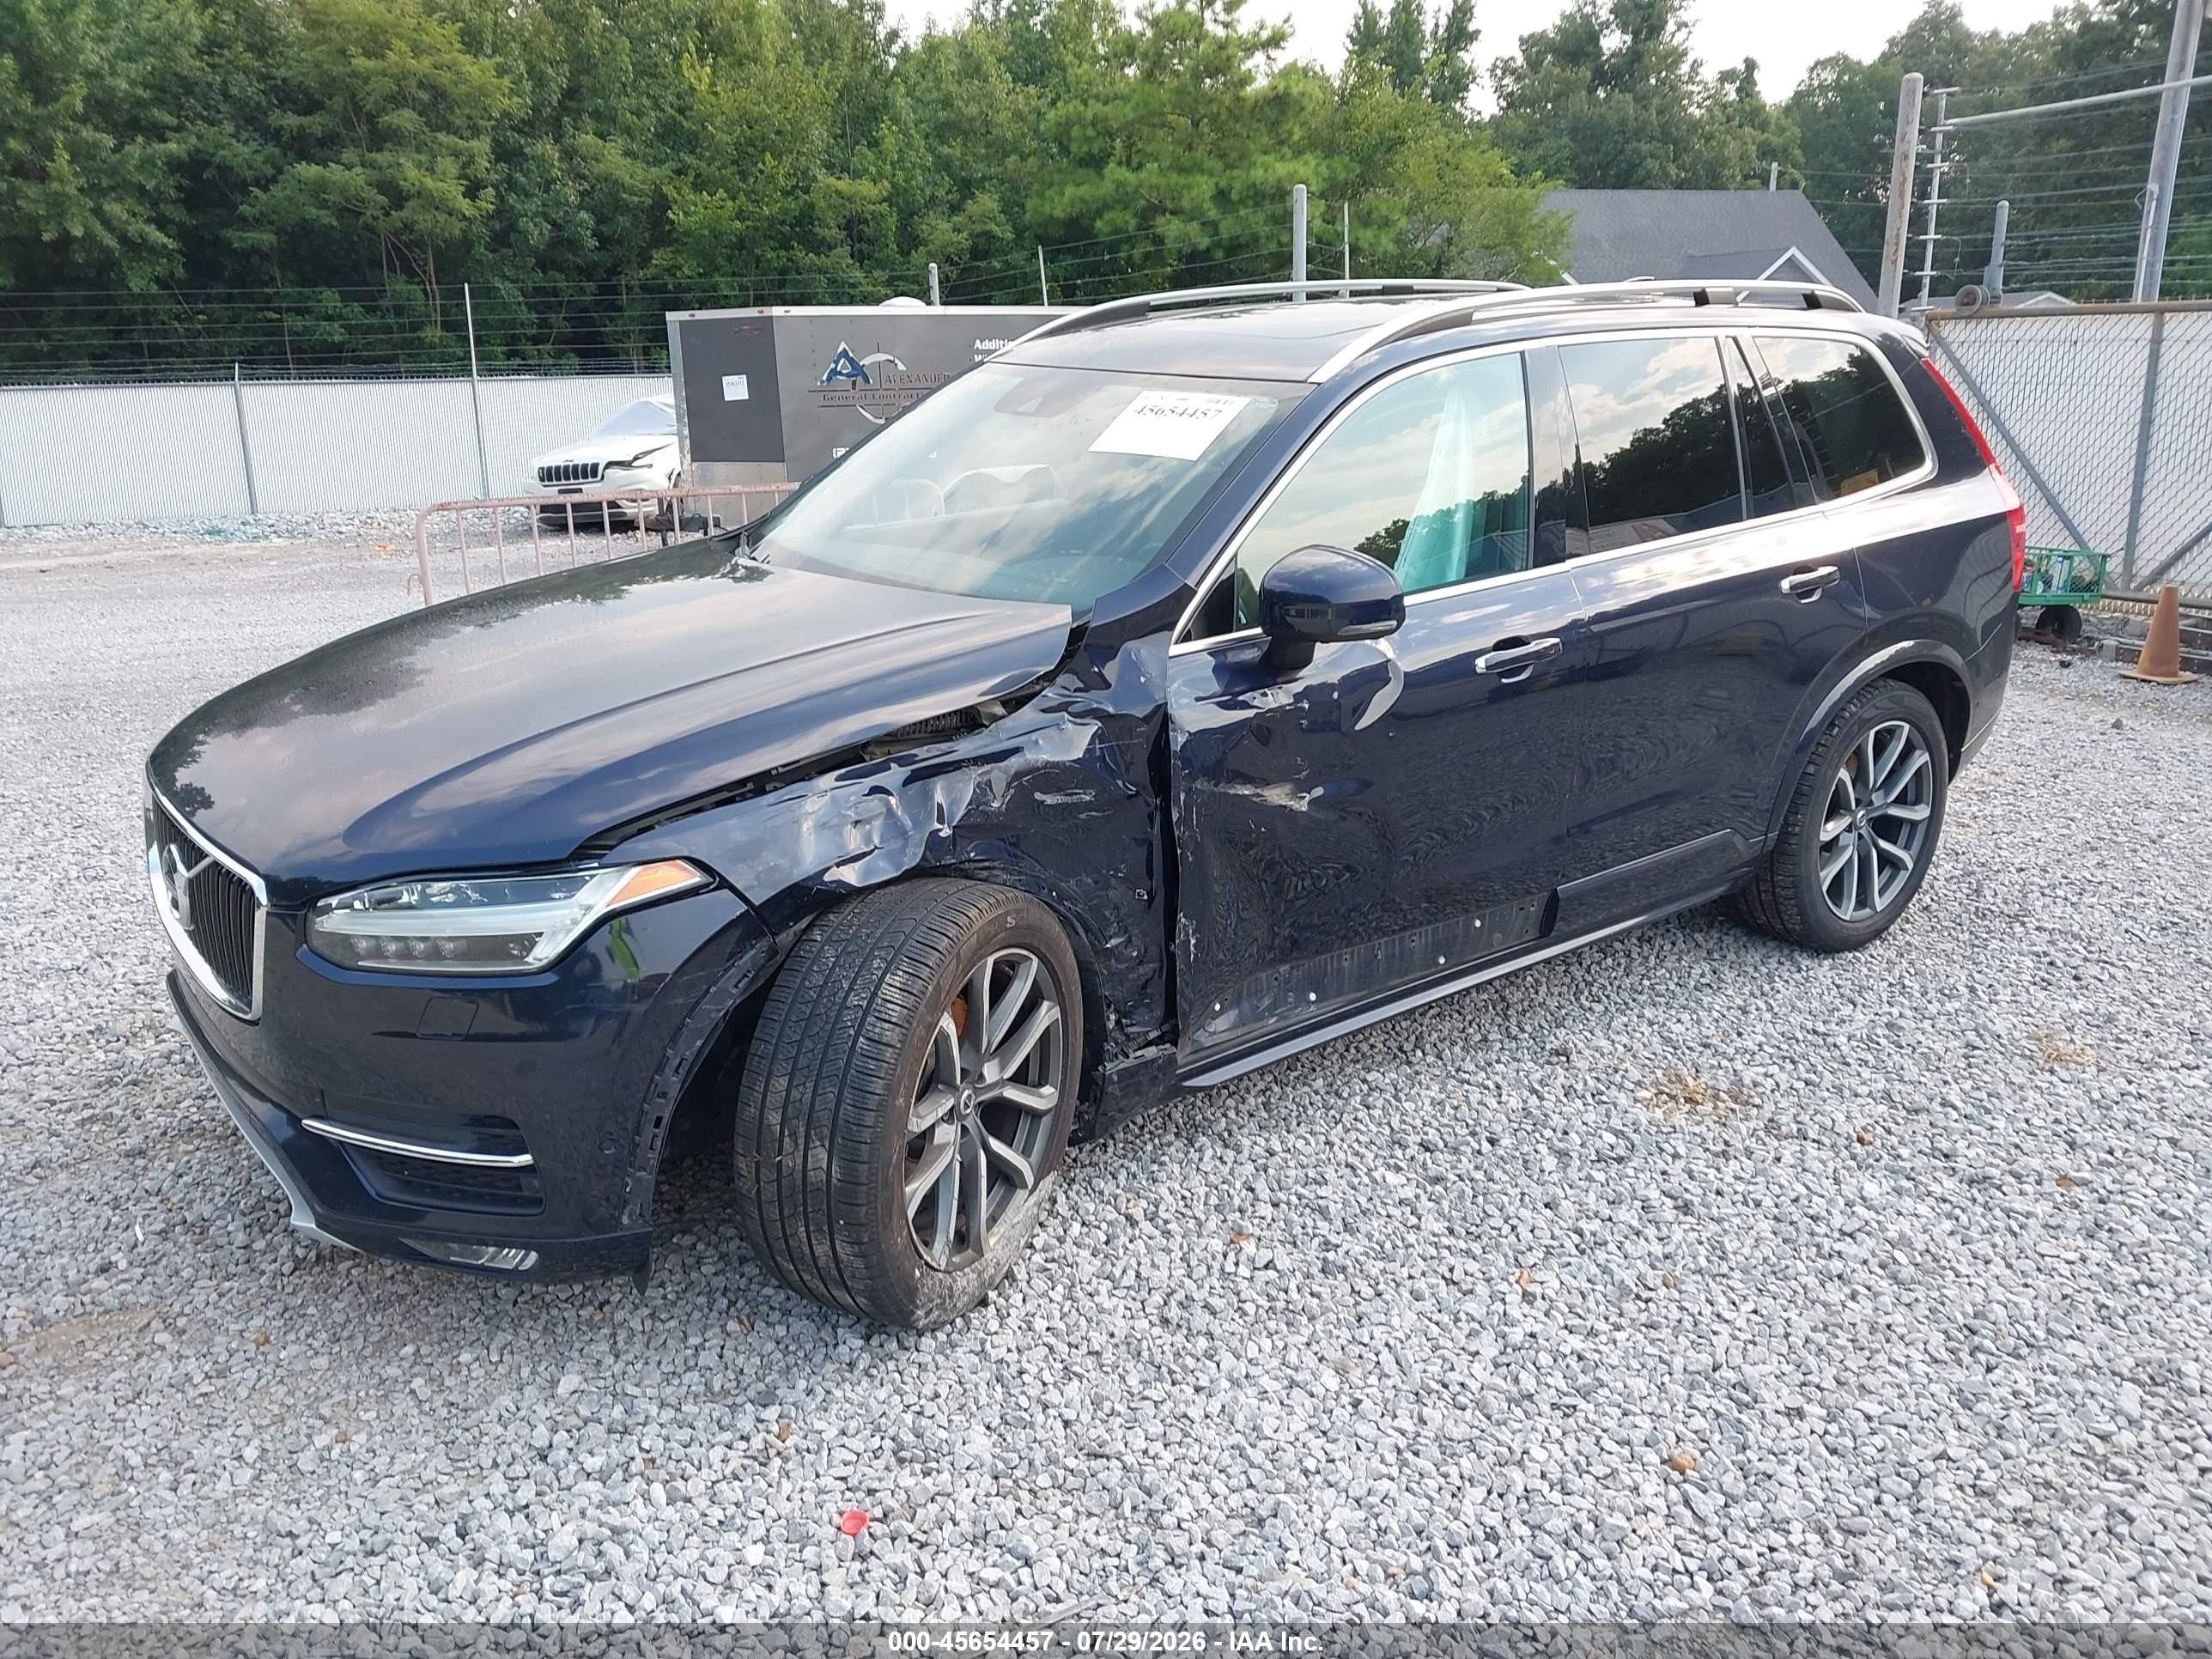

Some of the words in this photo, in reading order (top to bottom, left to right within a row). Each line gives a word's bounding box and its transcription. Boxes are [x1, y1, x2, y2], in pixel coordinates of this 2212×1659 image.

[973, 337, 1012, 350] Additi
[822, 392, 868, 402] General
[872, 391, 924, 400] Contract
